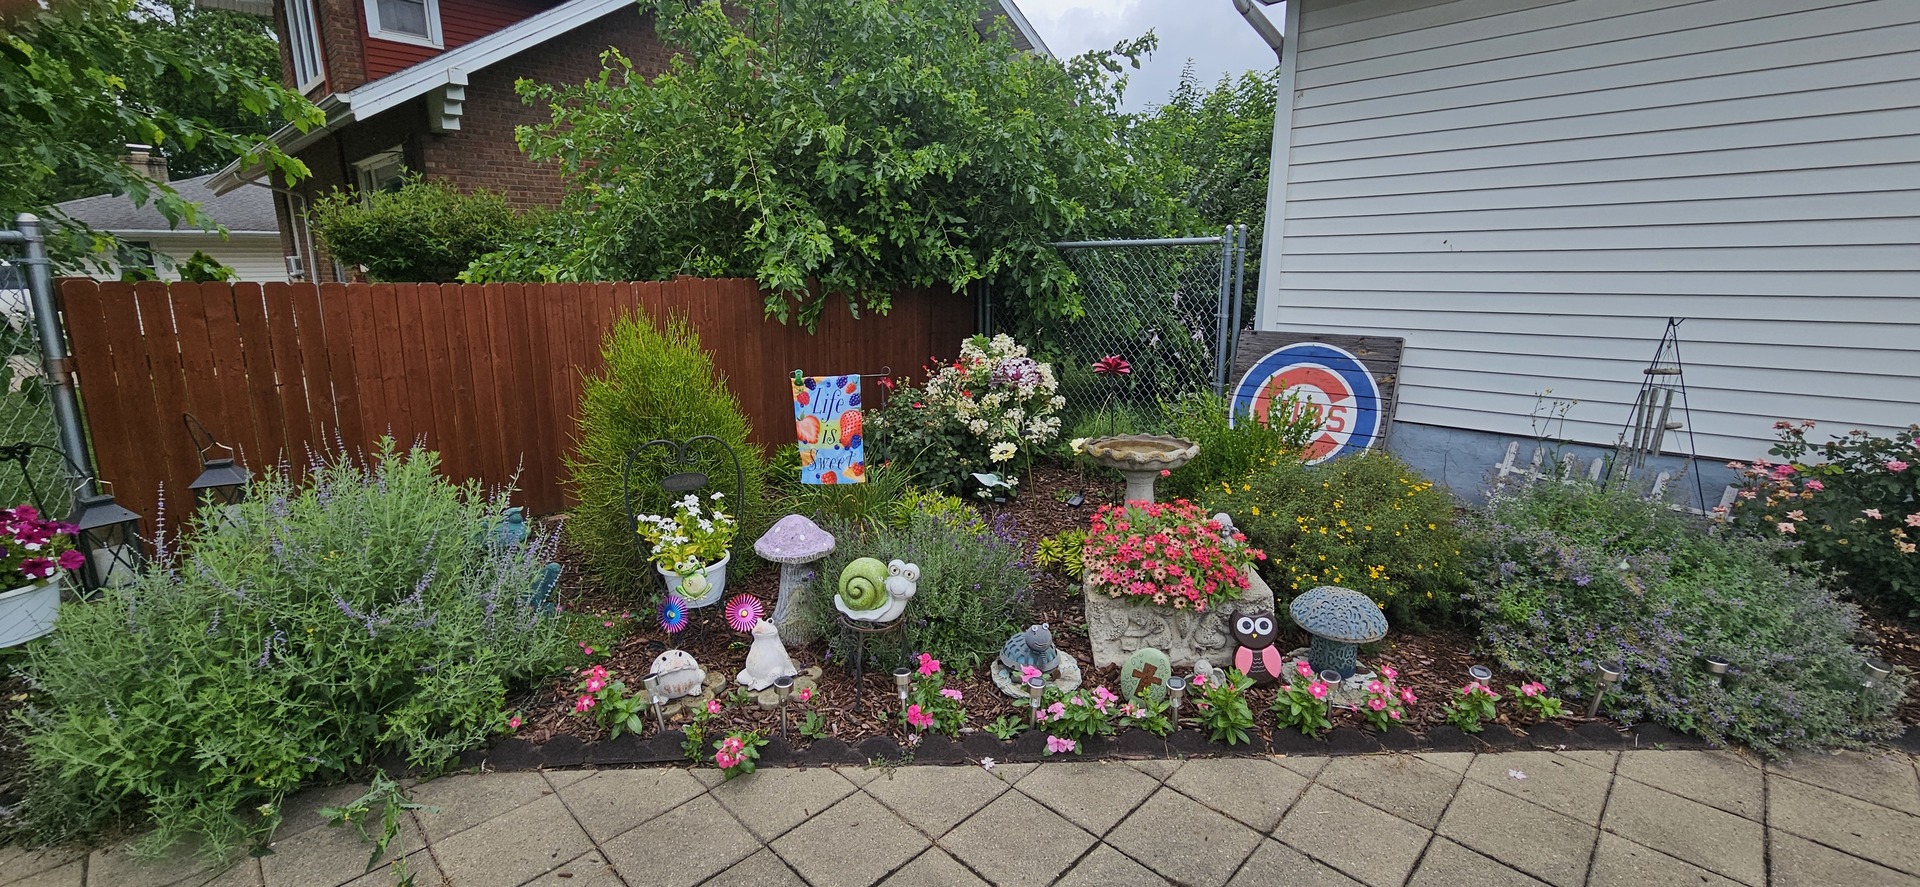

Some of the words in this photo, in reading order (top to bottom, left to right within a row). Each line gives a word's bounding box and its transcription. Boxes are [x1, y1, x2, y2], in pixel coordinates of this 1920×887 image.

[812, 388, 844, 423] Life
[822, 424, 837, 445] is
[808, 449, 856, 471] Sweet
